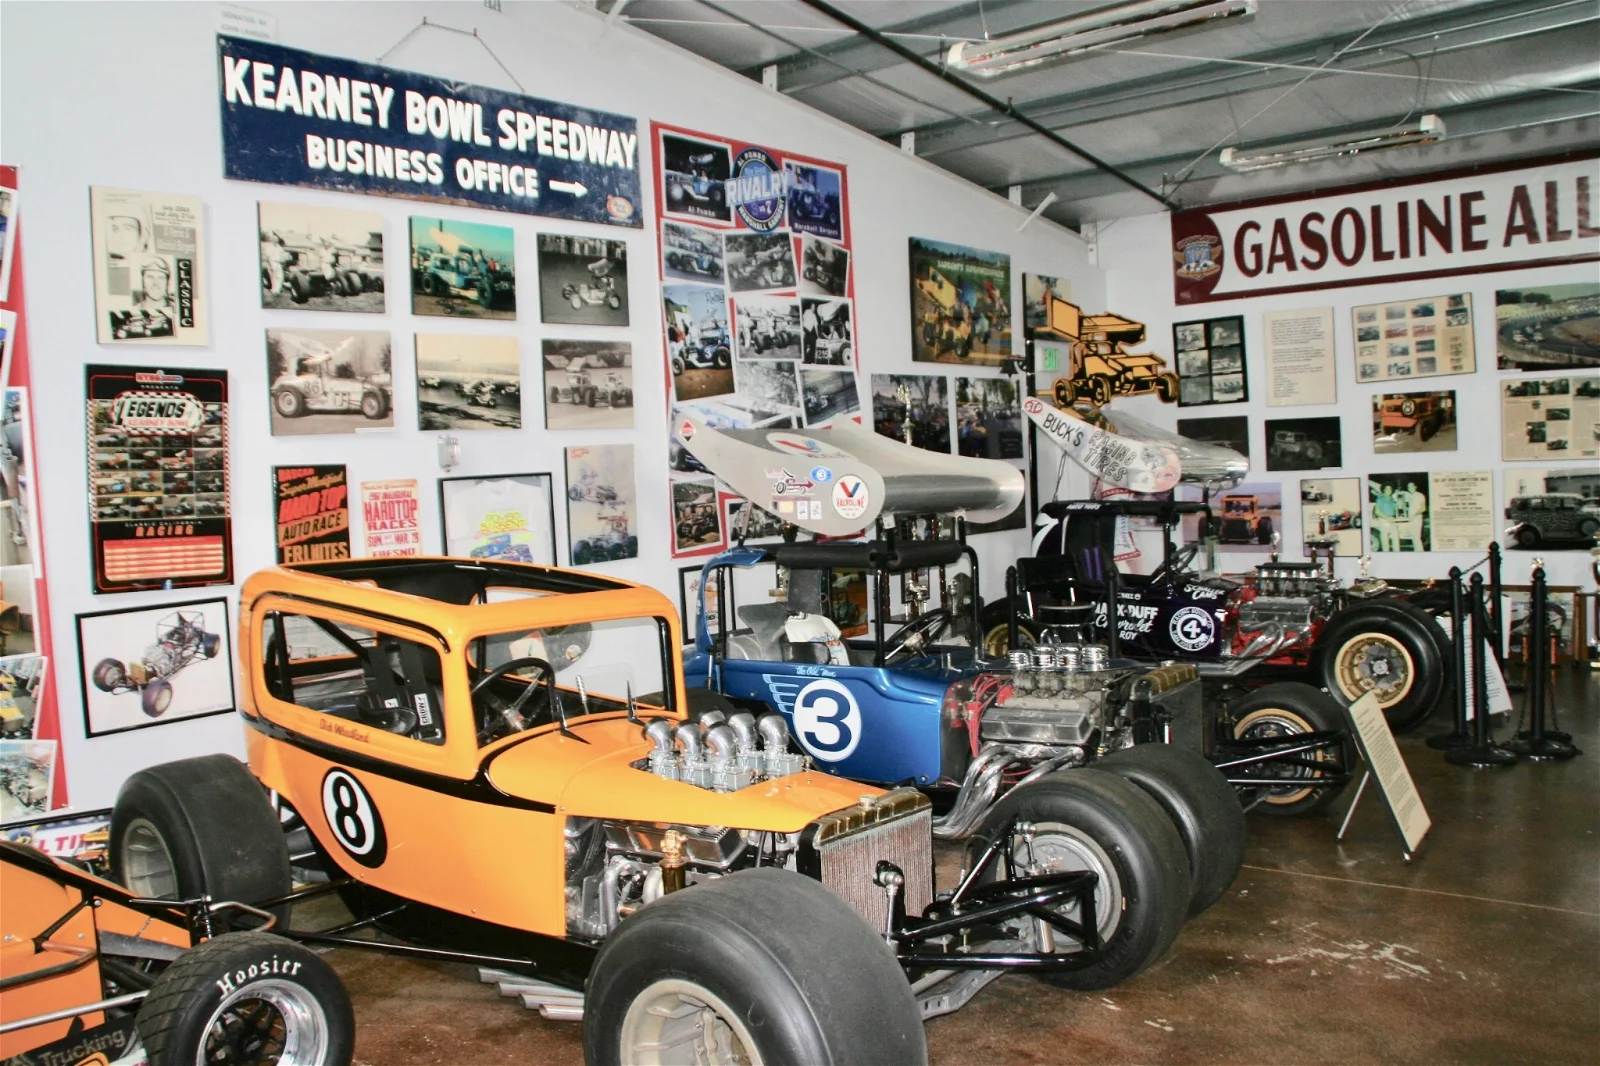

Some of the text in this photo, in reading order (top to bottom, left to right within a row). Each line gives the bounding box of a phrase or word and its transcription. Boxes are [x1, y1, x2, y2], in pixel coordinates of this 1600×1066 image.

[223, 55, 636, 170] KEARNEY BOWL SPEEDWAY
[306, 133, 540, 199] BUSINESS OFFICE
[724, 169, 789, 205] RIVALRY
[765, 200, 772, 214] 7
[1234, 175, 1600, 278] GASOLINE ALL
[178, 260, 193, 327] CLASSIC
[115, 400, 186, 425] LEGENDS
[1024, 401, 1043, 413] STP
[1043, 413, 1084, 447] BUCK'S
[1083, 448, 1128, 482] TIRES
[1088, 430, 1138, 466] RACING
[364, 498, 417, 521] HARDTOP
[836, 497, 864, 508] VALVOLINE
[135, 524, 194, 537] RACING
[282, 511, 342, 541] AUTO RACE
[368, 518, 417, 531] RACES
[1031, 513, 1059, 557] 7
[372, 547, 416, 557] FRESNO
[1119, 630, 1139, 641] ROY
[1183, 619, 1201, 639] 4
[802, 688, 852, 752] 3
[331, 775, 367, 849] 8
[216, 954, 302, 1000] Hoosier
[38, 1028, 126, 1066] Trucking
